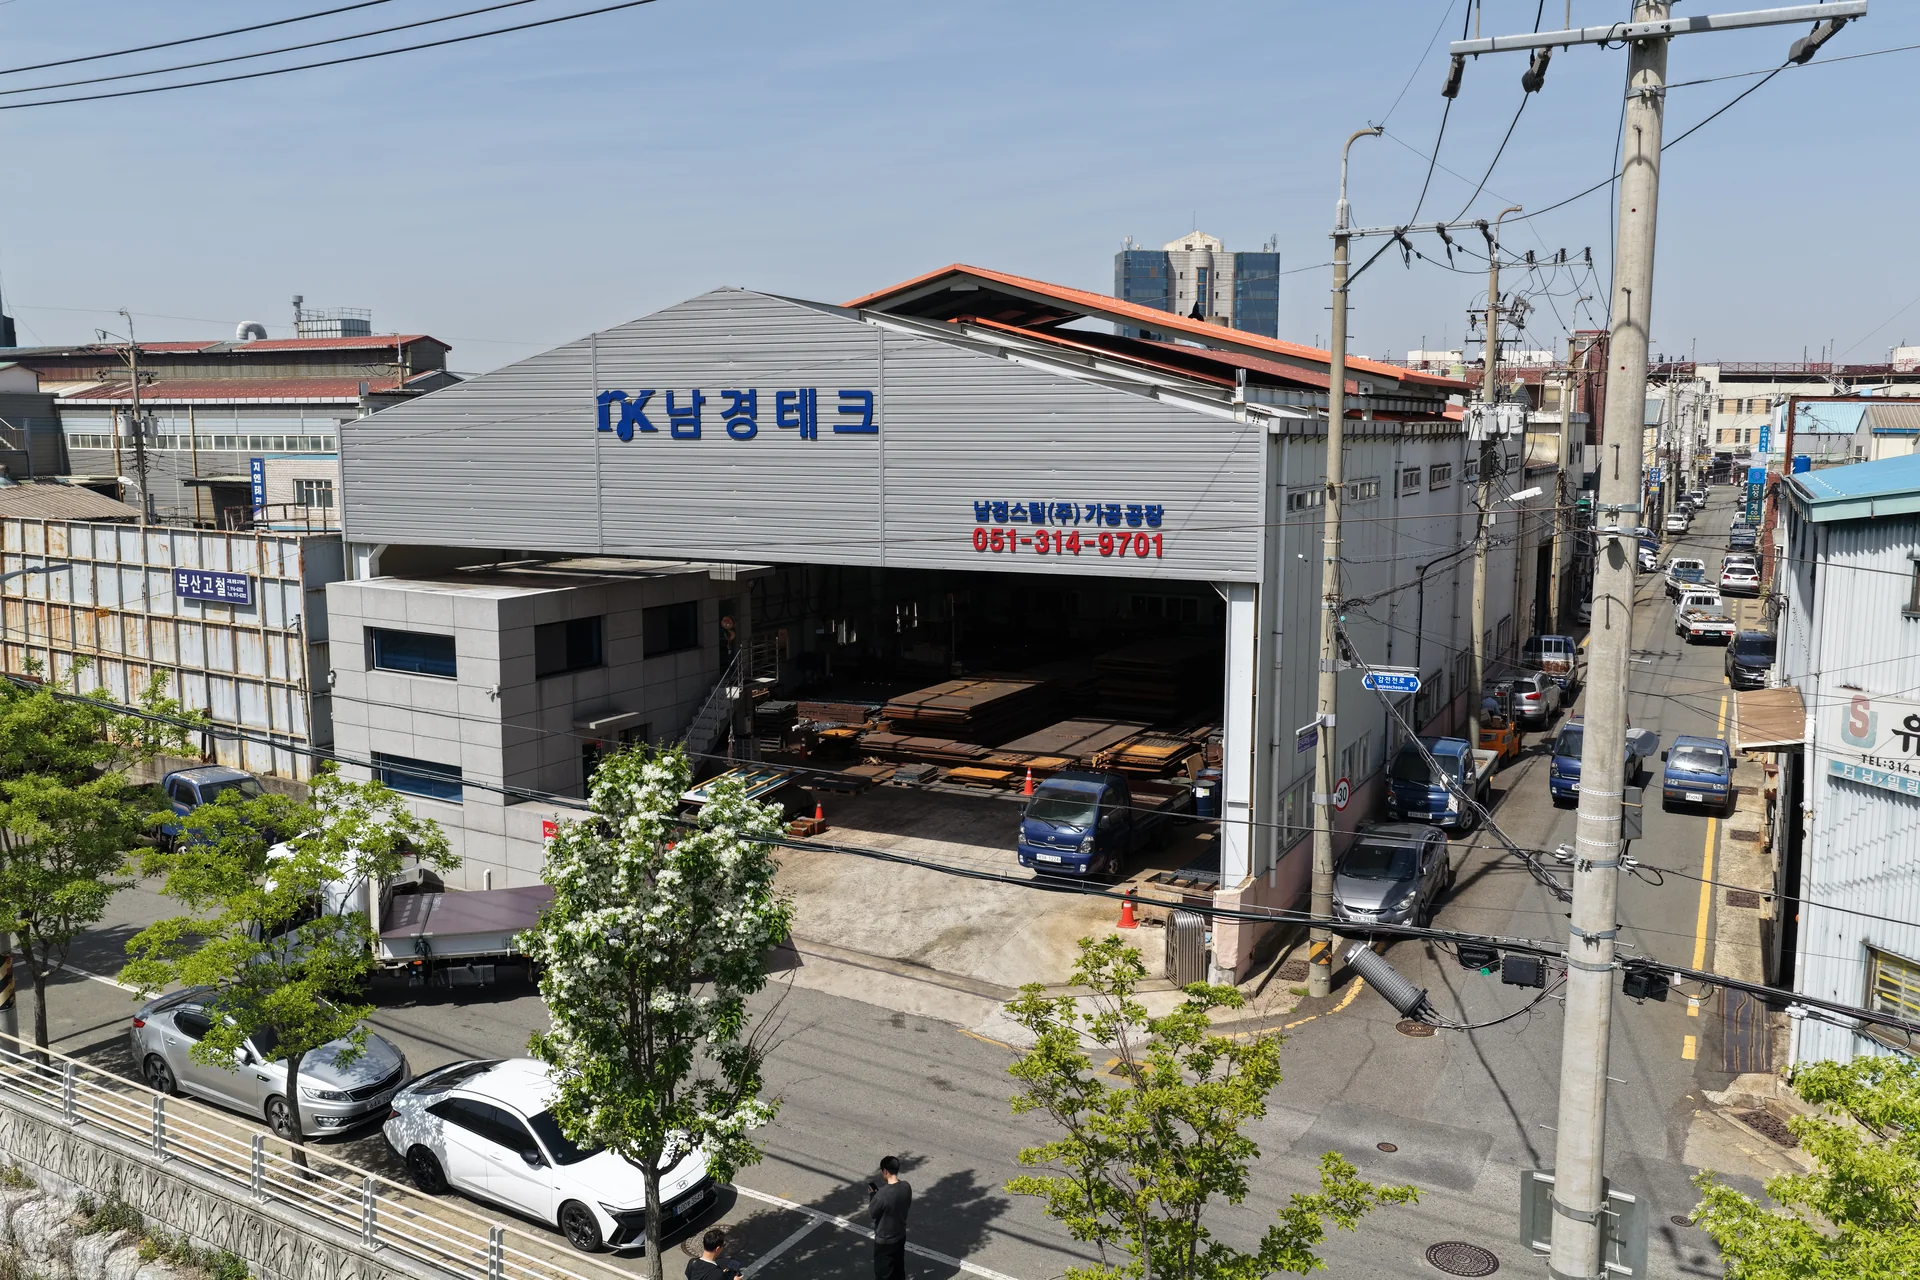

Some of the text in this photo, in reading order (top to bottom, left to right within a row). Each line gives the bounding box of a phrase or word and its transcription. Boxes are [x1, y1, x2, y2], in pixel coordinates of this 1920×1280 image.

[666, 388, 879, 441] 남경테크
[972, 527, 1164, 558] 051-314-9701
[178, 573, 226, 597] 부산고철
[1378, 676, 1405, 685] 감전천로
[1861, 754, 1920, 777] TEL:314-
[1338, 786, 1347, 802] 30
